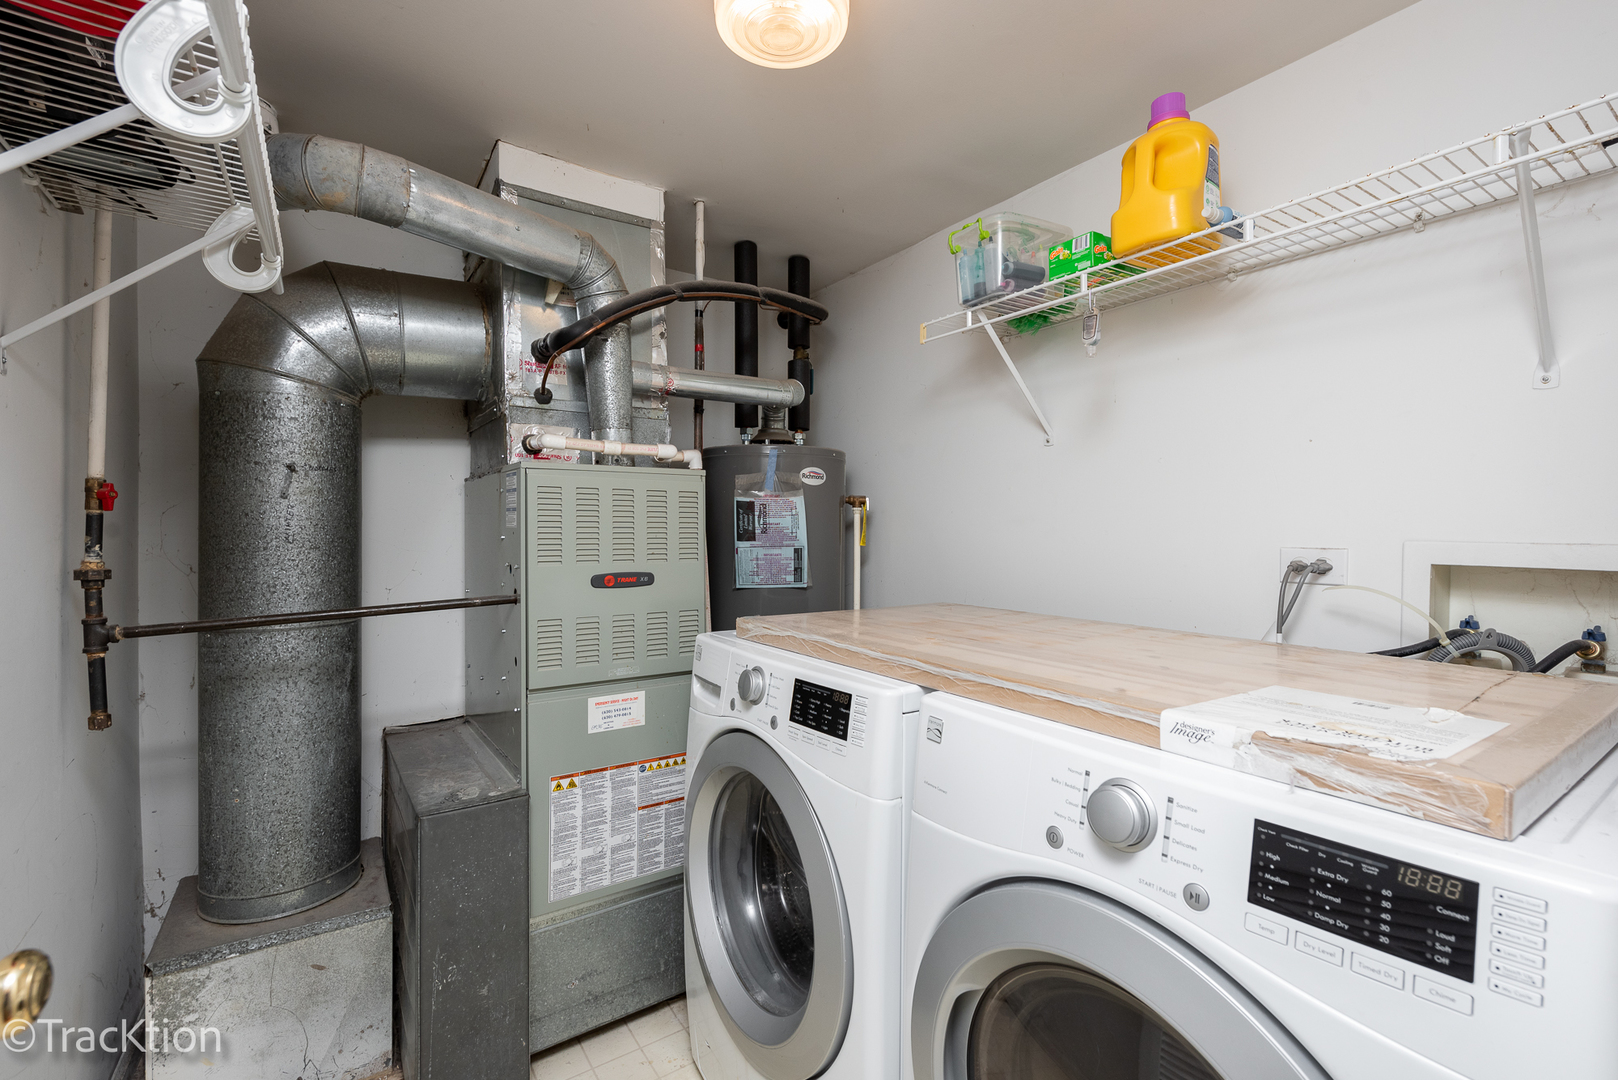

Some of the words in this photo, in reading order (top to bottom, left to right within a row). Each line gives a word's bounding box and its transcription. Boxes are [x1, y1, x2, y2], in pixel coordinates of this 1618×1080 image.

[1050, 247, 1064, 260] Gain
[1094, 245, 1107, 254] Gain
[1170, 721, 1211, 744] Image
[1179, 721, 1215, 736] designer's
[1067, 767, 1083, 776] Normal
[1064, 782, 1081, 793] Bedding
[1065, 799, 1079, 808] Casual
[1176, 802, 1198, 813] Sanitize
[1054, 811, 1066, 820] Heavy
[1067, 816, 1077, 824] Duty
[1174, 819, 1190, 829] Small
[1190, 825, 1206, 834] Load
[1172, 838, 1197, 852] Delicates
[1067, 847, 1084, 858] POWER
[1265, 851, 1281, 861] High
[1318, 851, 1327, 859] Dry
[1170, 855, 1191, 868] Express
[1192, 863, 1204, 873] Dry
[1264, 873, 1290, 886] Medium
[1317, 868, 1335, 879] Extra
[1336, 873, 1349, 884] Dry
[1138, 878, 1155, 889] START
[1159, 887, 1177, 899] PAUSE
[1381, 888, 1393, 898] 60
[1262, 893, 1276, 903] Low
[1315, 890, 1342, 904] Normal
[1380, 900, 1392, 909] 50
[1380, 912, 1392, 921] 40
[1435, 905, 1470, 922] Connect
[1314, 911, 1335, 925] Damp
[1336, 919, 1349, 930] Dry
[1258, 923, 1276, 936] Temp
[1379, 923, 1391, 933] 30
[1378, 934, 1390, 944] 20
[1435, 929, 1456, 943] Loud
[1302, 940, 1316, 952] Dry
[1317, 945, 1337, 959] Level
[1434, 942, 1452, 954] Soft
[1433, 954, 1450, 966] Off
[1358, 961, 1382, 975] Timed
[1383, 969, 1398, 982] Dry
[1429, 987, 1457, 1003] Chime
